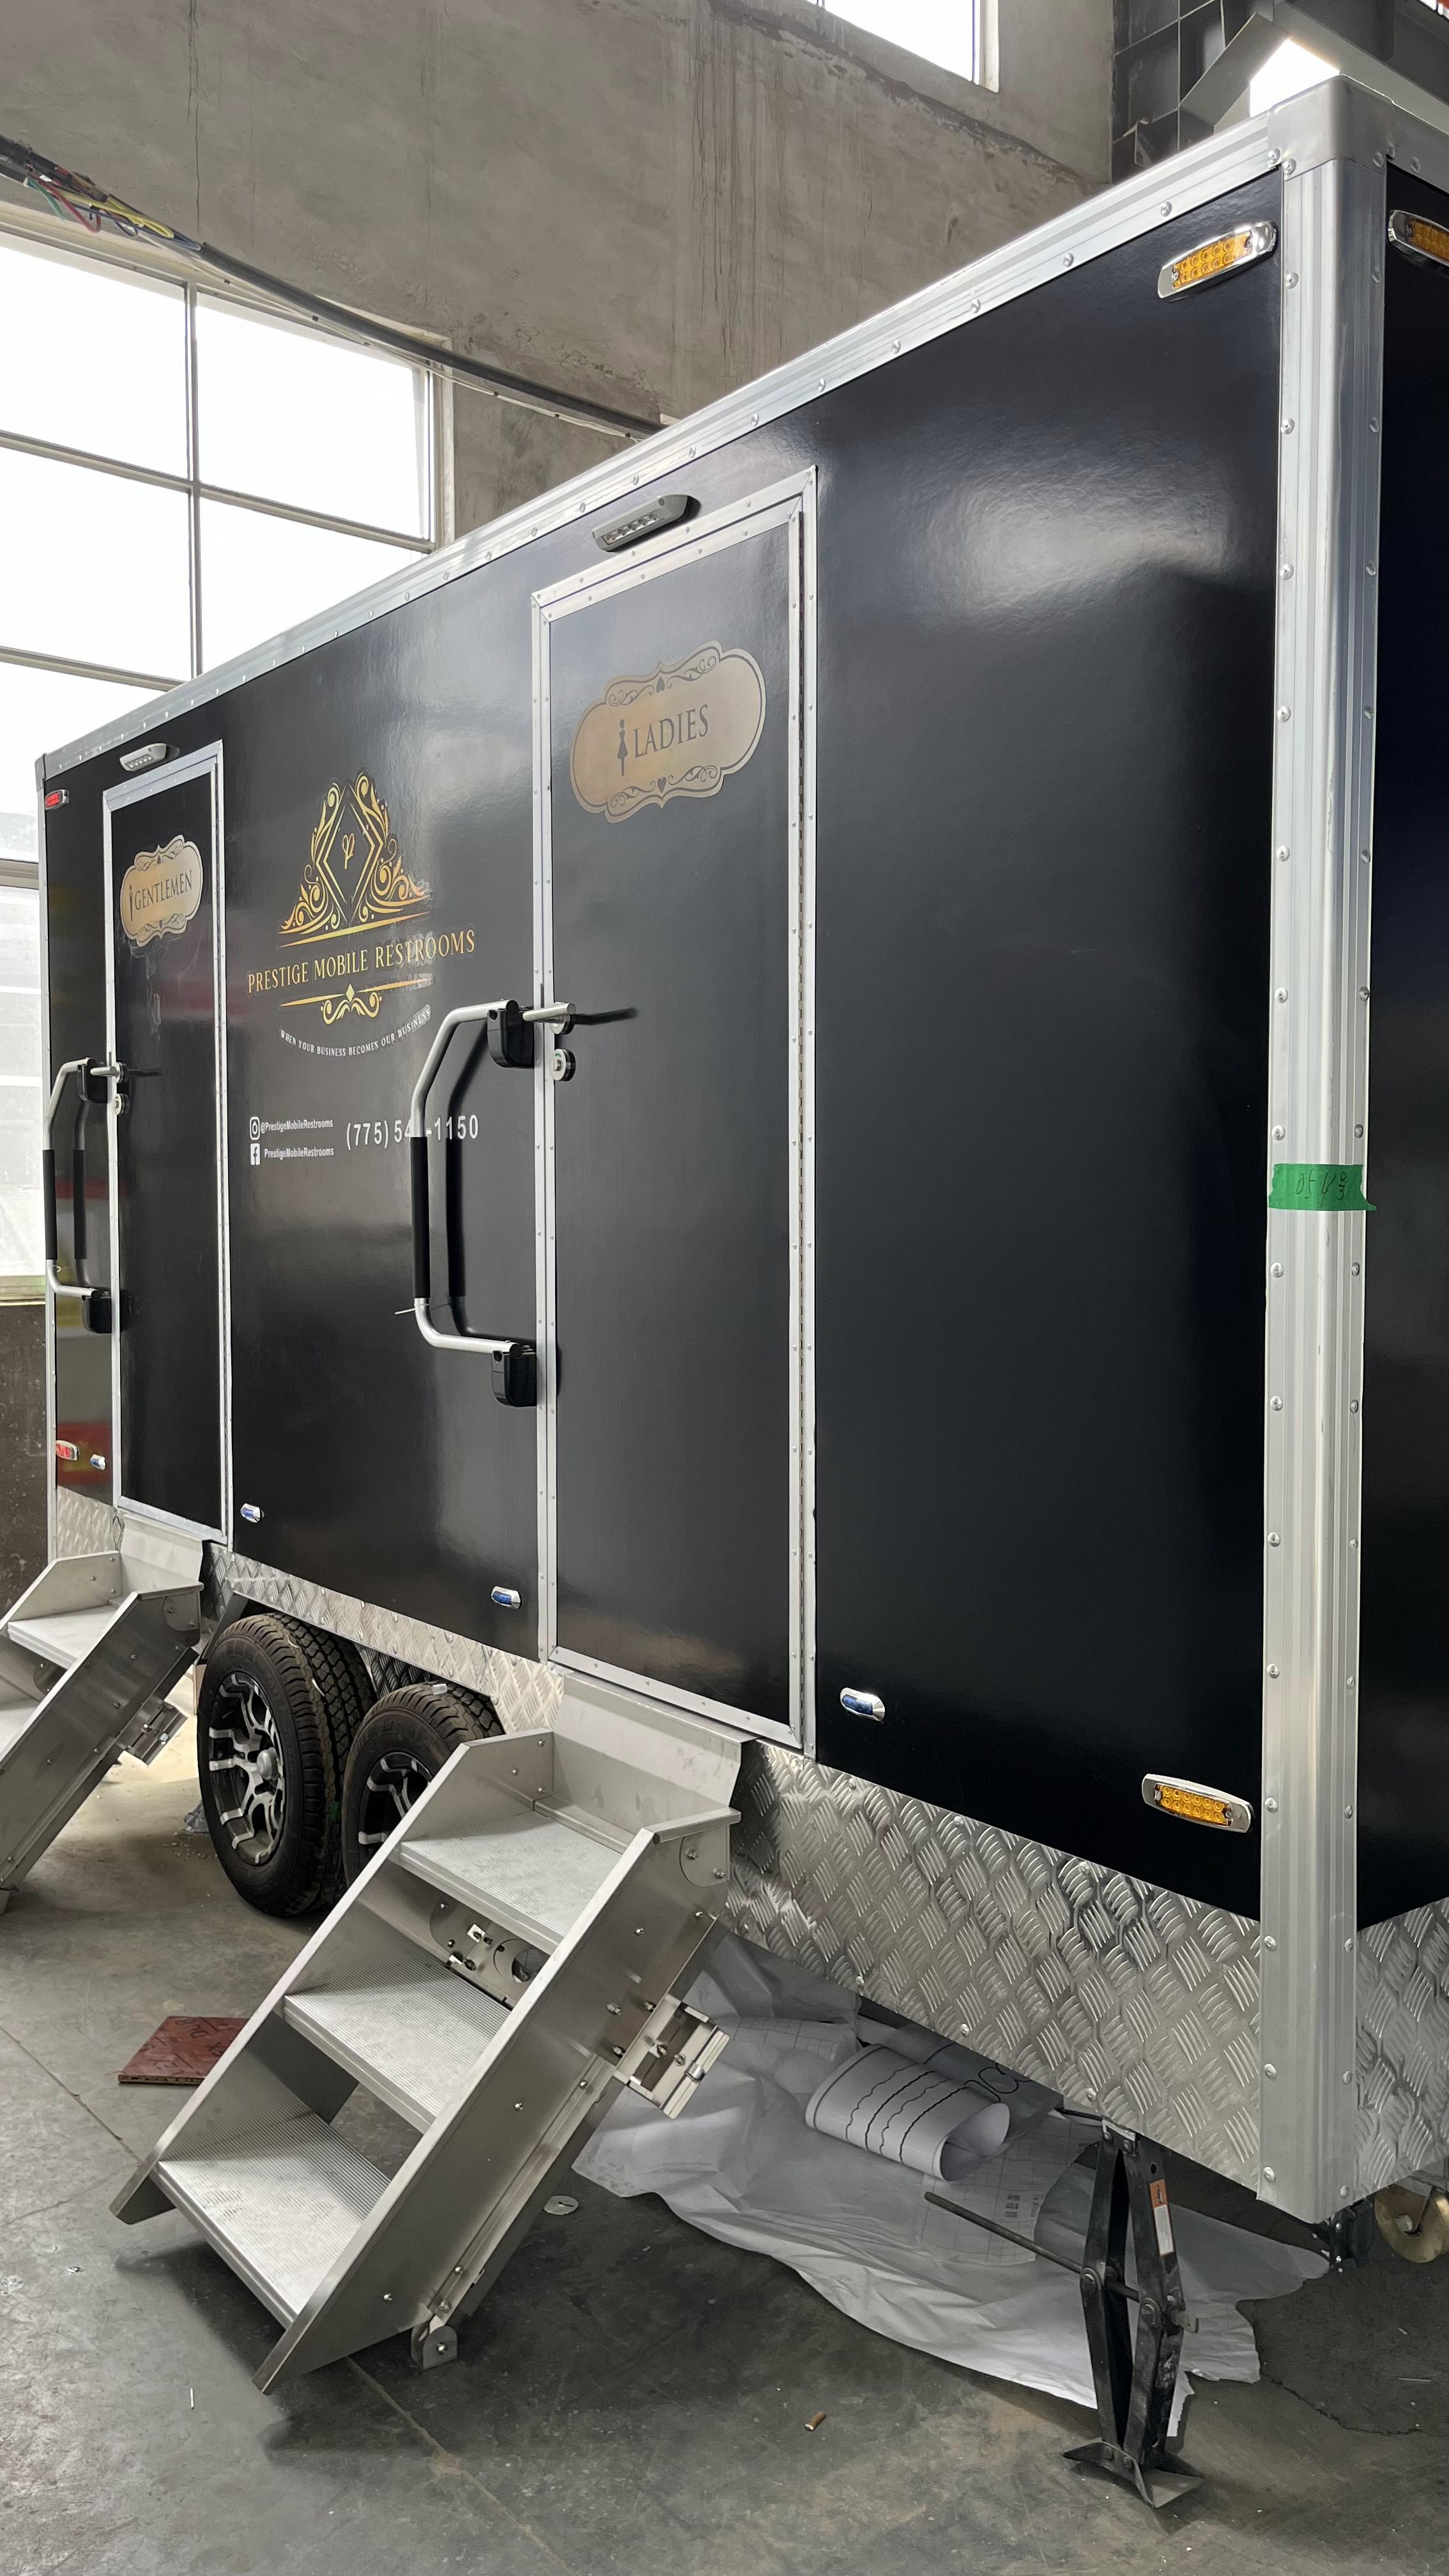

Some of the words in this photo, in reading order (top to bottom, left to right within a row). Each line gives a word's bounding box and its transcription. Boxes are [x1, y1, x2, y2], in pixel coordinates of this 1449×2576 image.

[633, 704, 709, 758] LADIES
[134, 870, 192, 910] GENTLEMEN
[248, 962, 309, 993] PRESTIGE
[314, 949, 368, 980] MOBILE
[375, 930, 475, 968] RESTROOMS
[280, 1029, 296, 1046] WHEN
[298, 1039, 315, 1054] YOUR
[317, 1046, 346, 1057] BUSINESS
[349, 1041, 379, 1056] BECOMES
[381, 1032, 395, 1046] OUR
[397, 1008, 431, 1039] BUSINESS
[260, 1119, 334, 1133] @PrestigeMobileRestrooms
[347, 1120, 388, 1150] (775)
[394, 1114, 479, 1143] 54-1150
[264, 1147, 334, 1160] PrestigeMobileRestrooms
